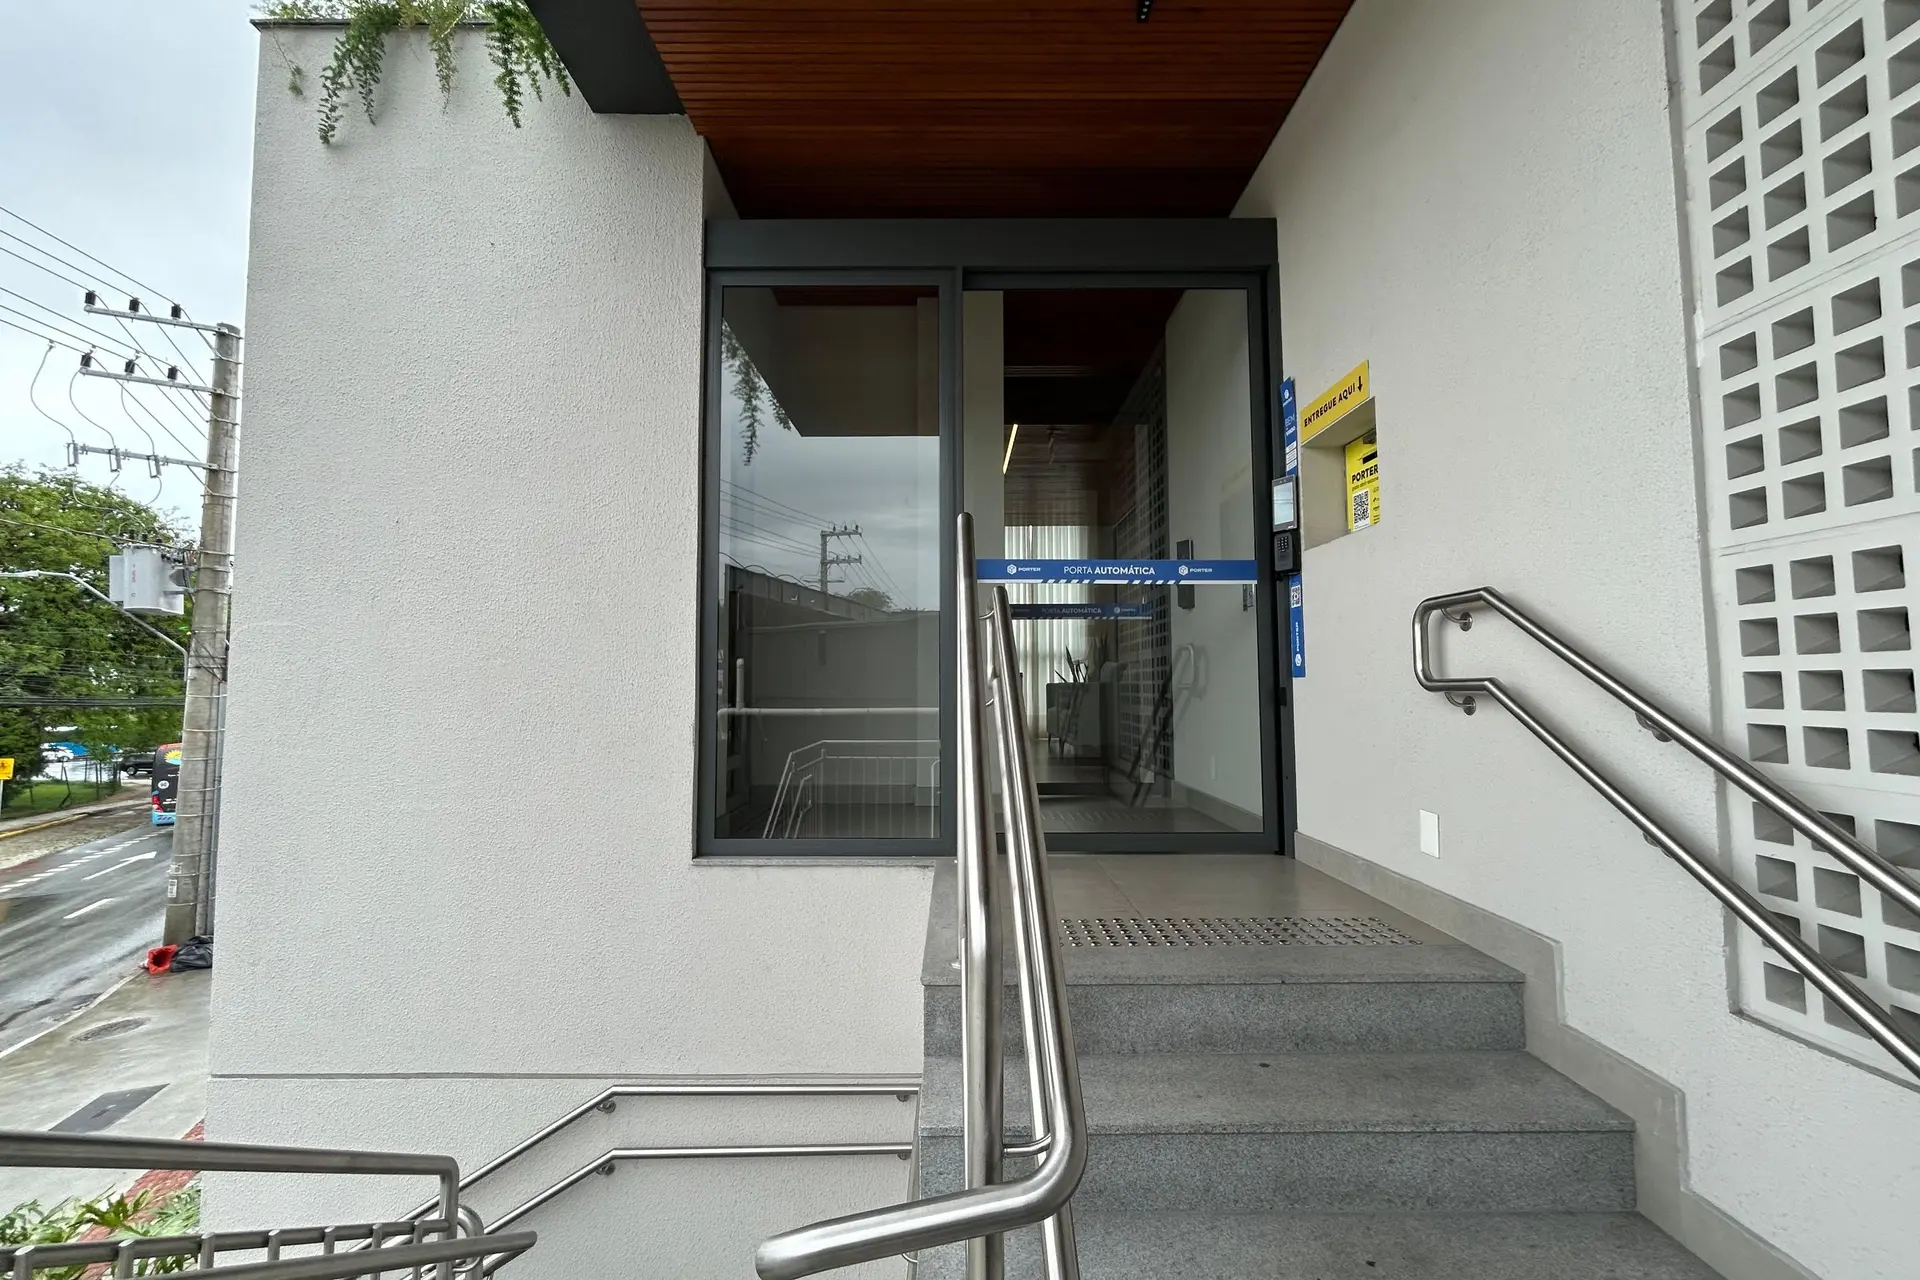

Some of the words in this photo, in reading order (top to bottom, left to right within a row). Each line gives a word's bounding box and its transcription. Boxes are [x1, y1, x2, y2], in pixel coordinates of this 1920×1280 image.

[1304, 397, 1337, 427] ENTREGUE
[1338, 383, 1356, 403] AQUI
[1351, 464, 1379, 484] PORTER
[1063, 566, 1093, 575] PORTA
[1094, 565, 1155, 575] AUTOMÁTICA
